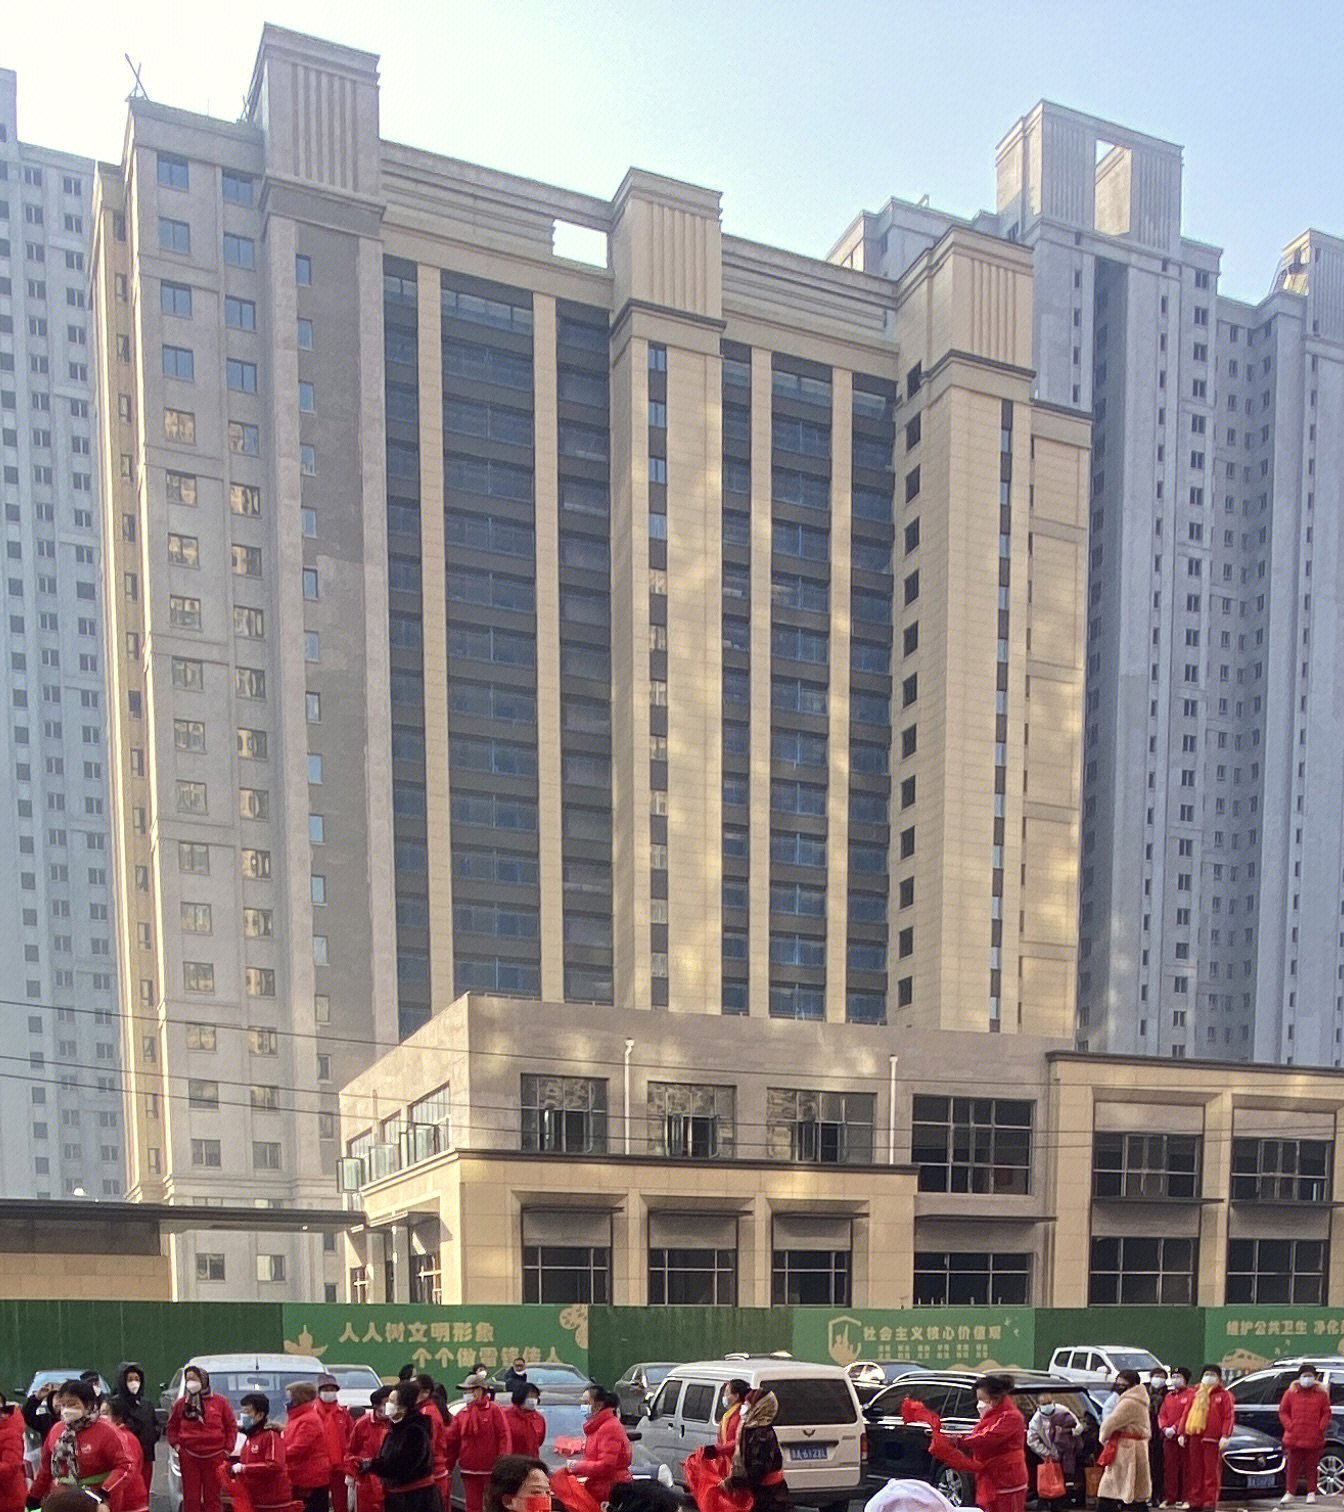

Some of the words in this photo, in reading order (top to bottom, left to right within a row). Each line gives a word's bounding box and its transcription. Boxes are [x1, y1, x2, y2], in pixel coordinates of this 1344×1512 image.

[338, 1322, 494, 1343] 人人树文明形象
[863, 1325, 1001, 1340] 社会主义核心价值观
